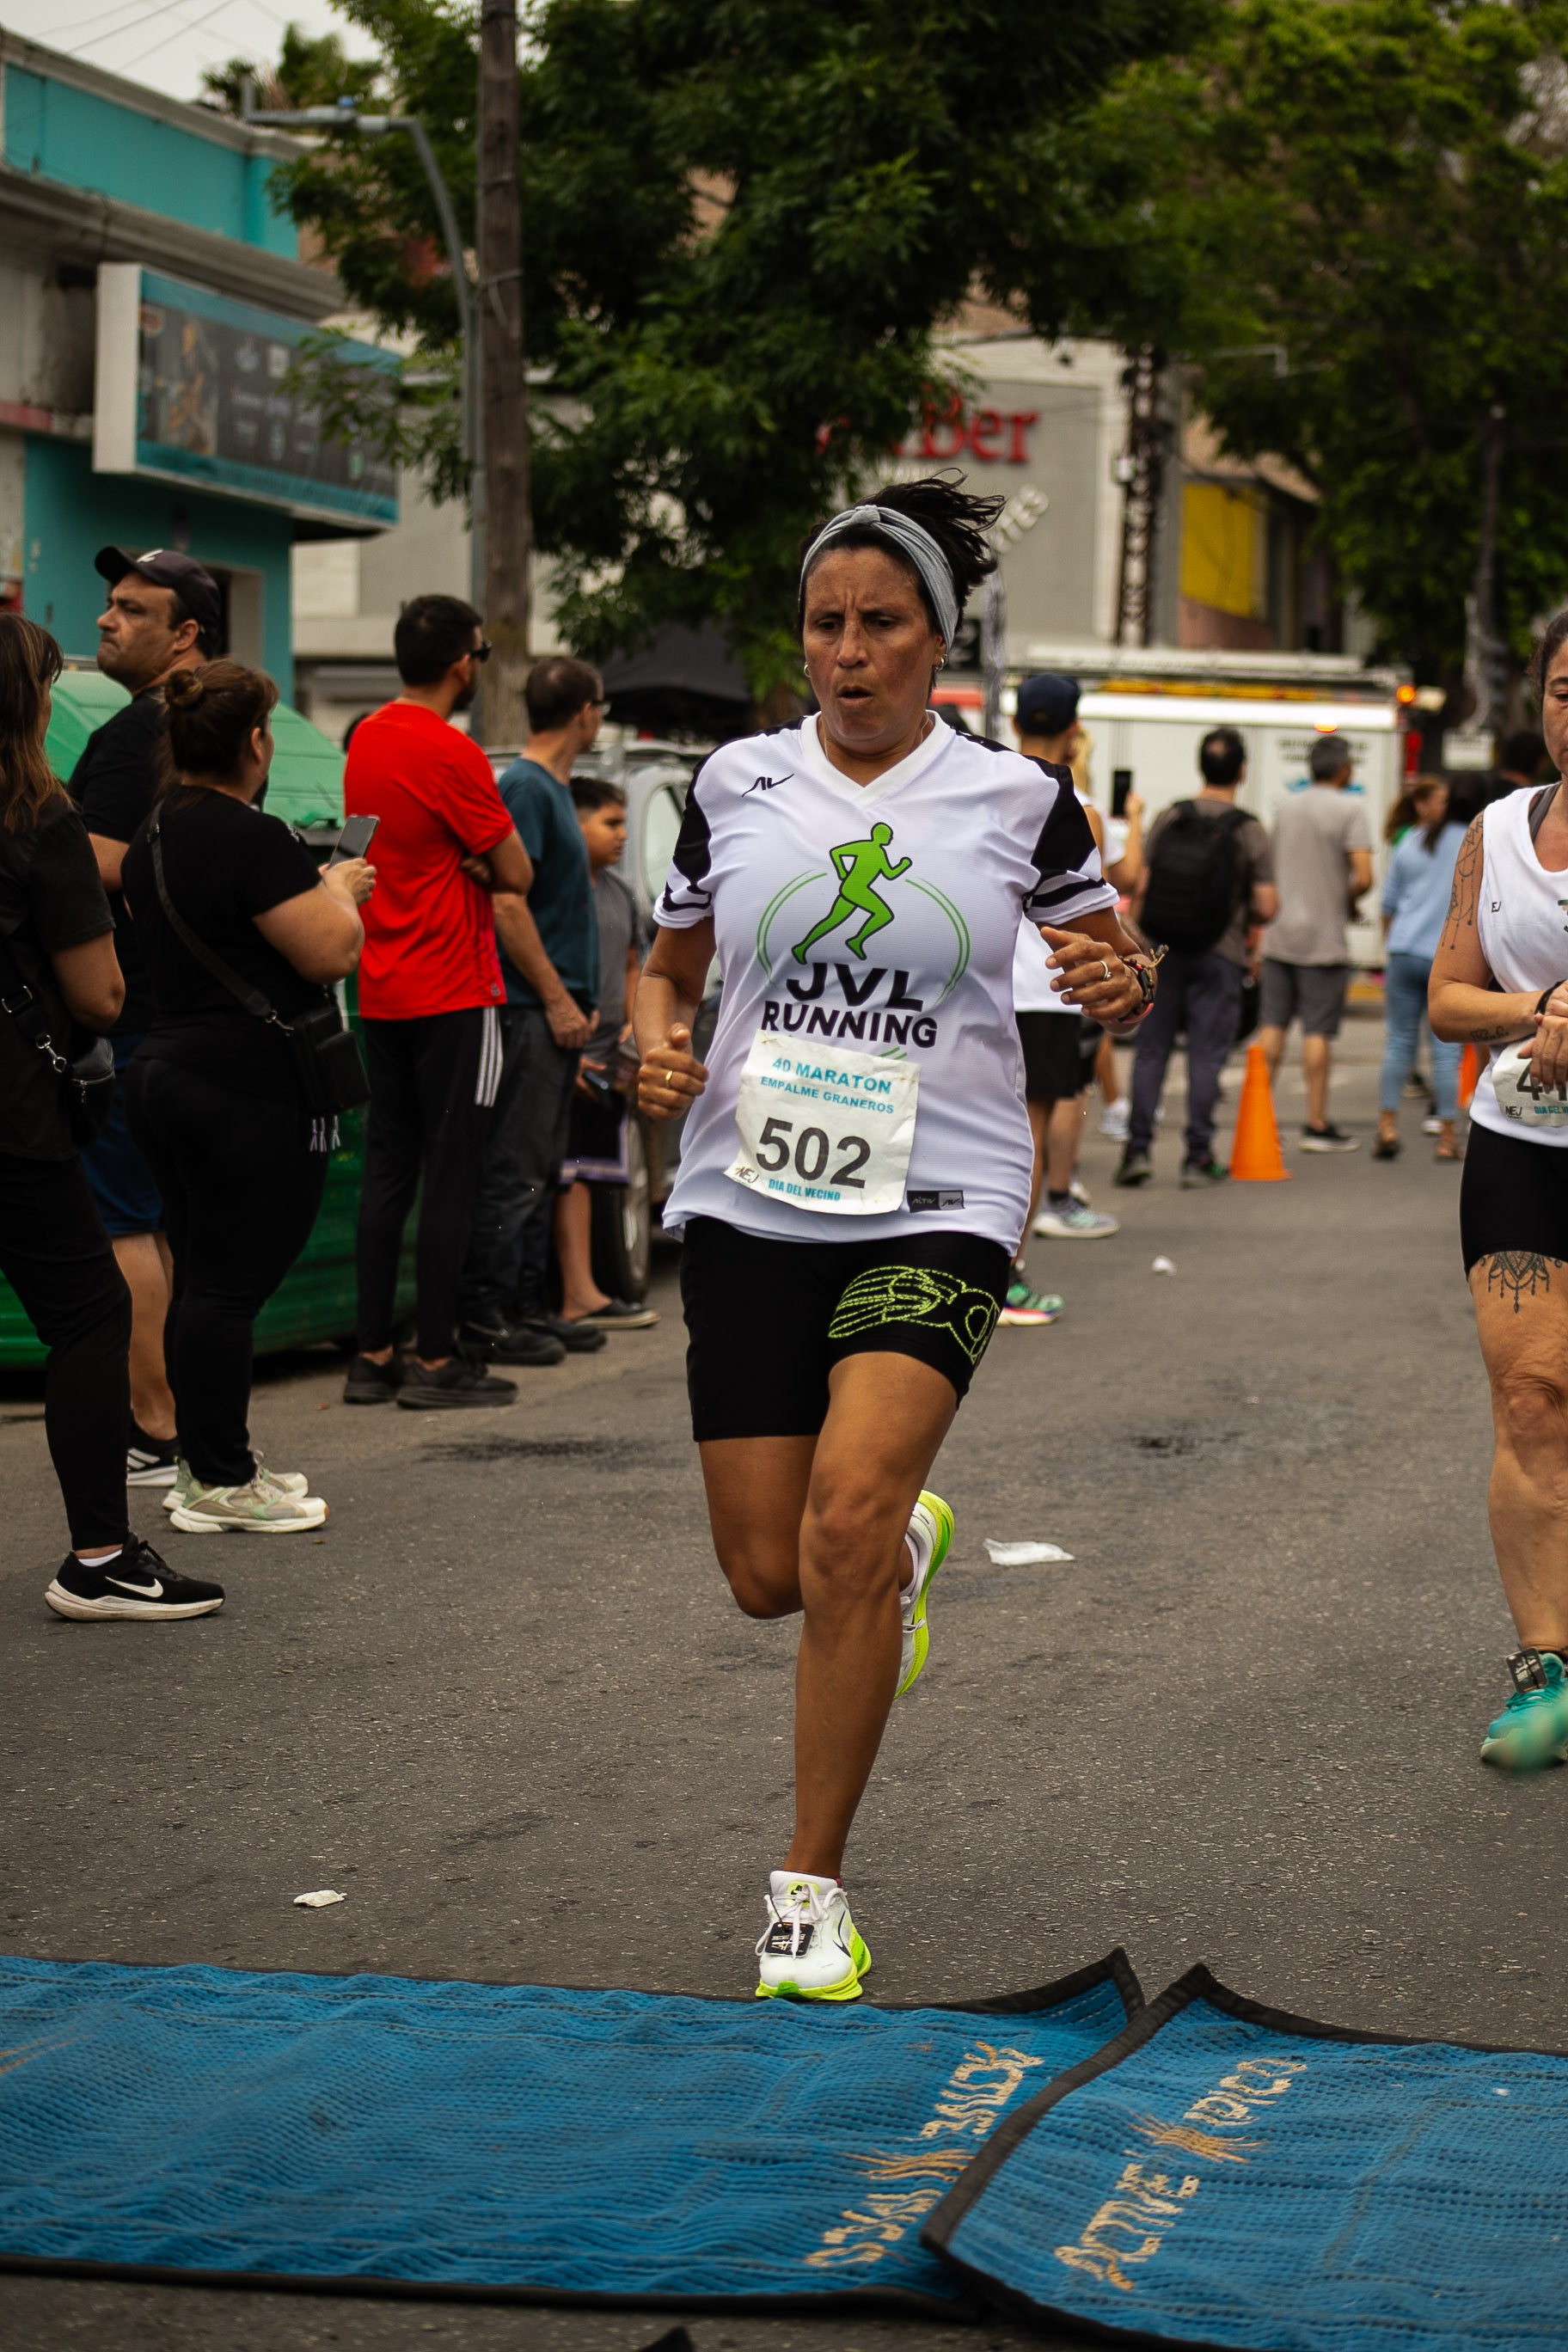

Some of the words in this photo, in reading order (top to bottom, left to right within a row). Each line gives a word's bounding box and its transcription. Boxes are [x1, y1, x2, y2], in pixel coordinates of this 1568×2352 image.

[786, 962, 926, 1013] JVL
[761, 1000, 939, 1049] RUNNING
[760, 1075, 819, 1099] EMPALME
[823, 1092, 895, 1114] GRANEROS
[772, 1057, 791, 1073] 40
[795, 1063, 891, 1094] MARATON
[756, 1117, 871, 1189] 502
[768, 1179, 785, 1191] DIA
[786, 1182, 802, 1197] DEL
[805, 1185, 842, 1202] VECINO
[1054, 2163, 1200, 2292] ACTIVE
